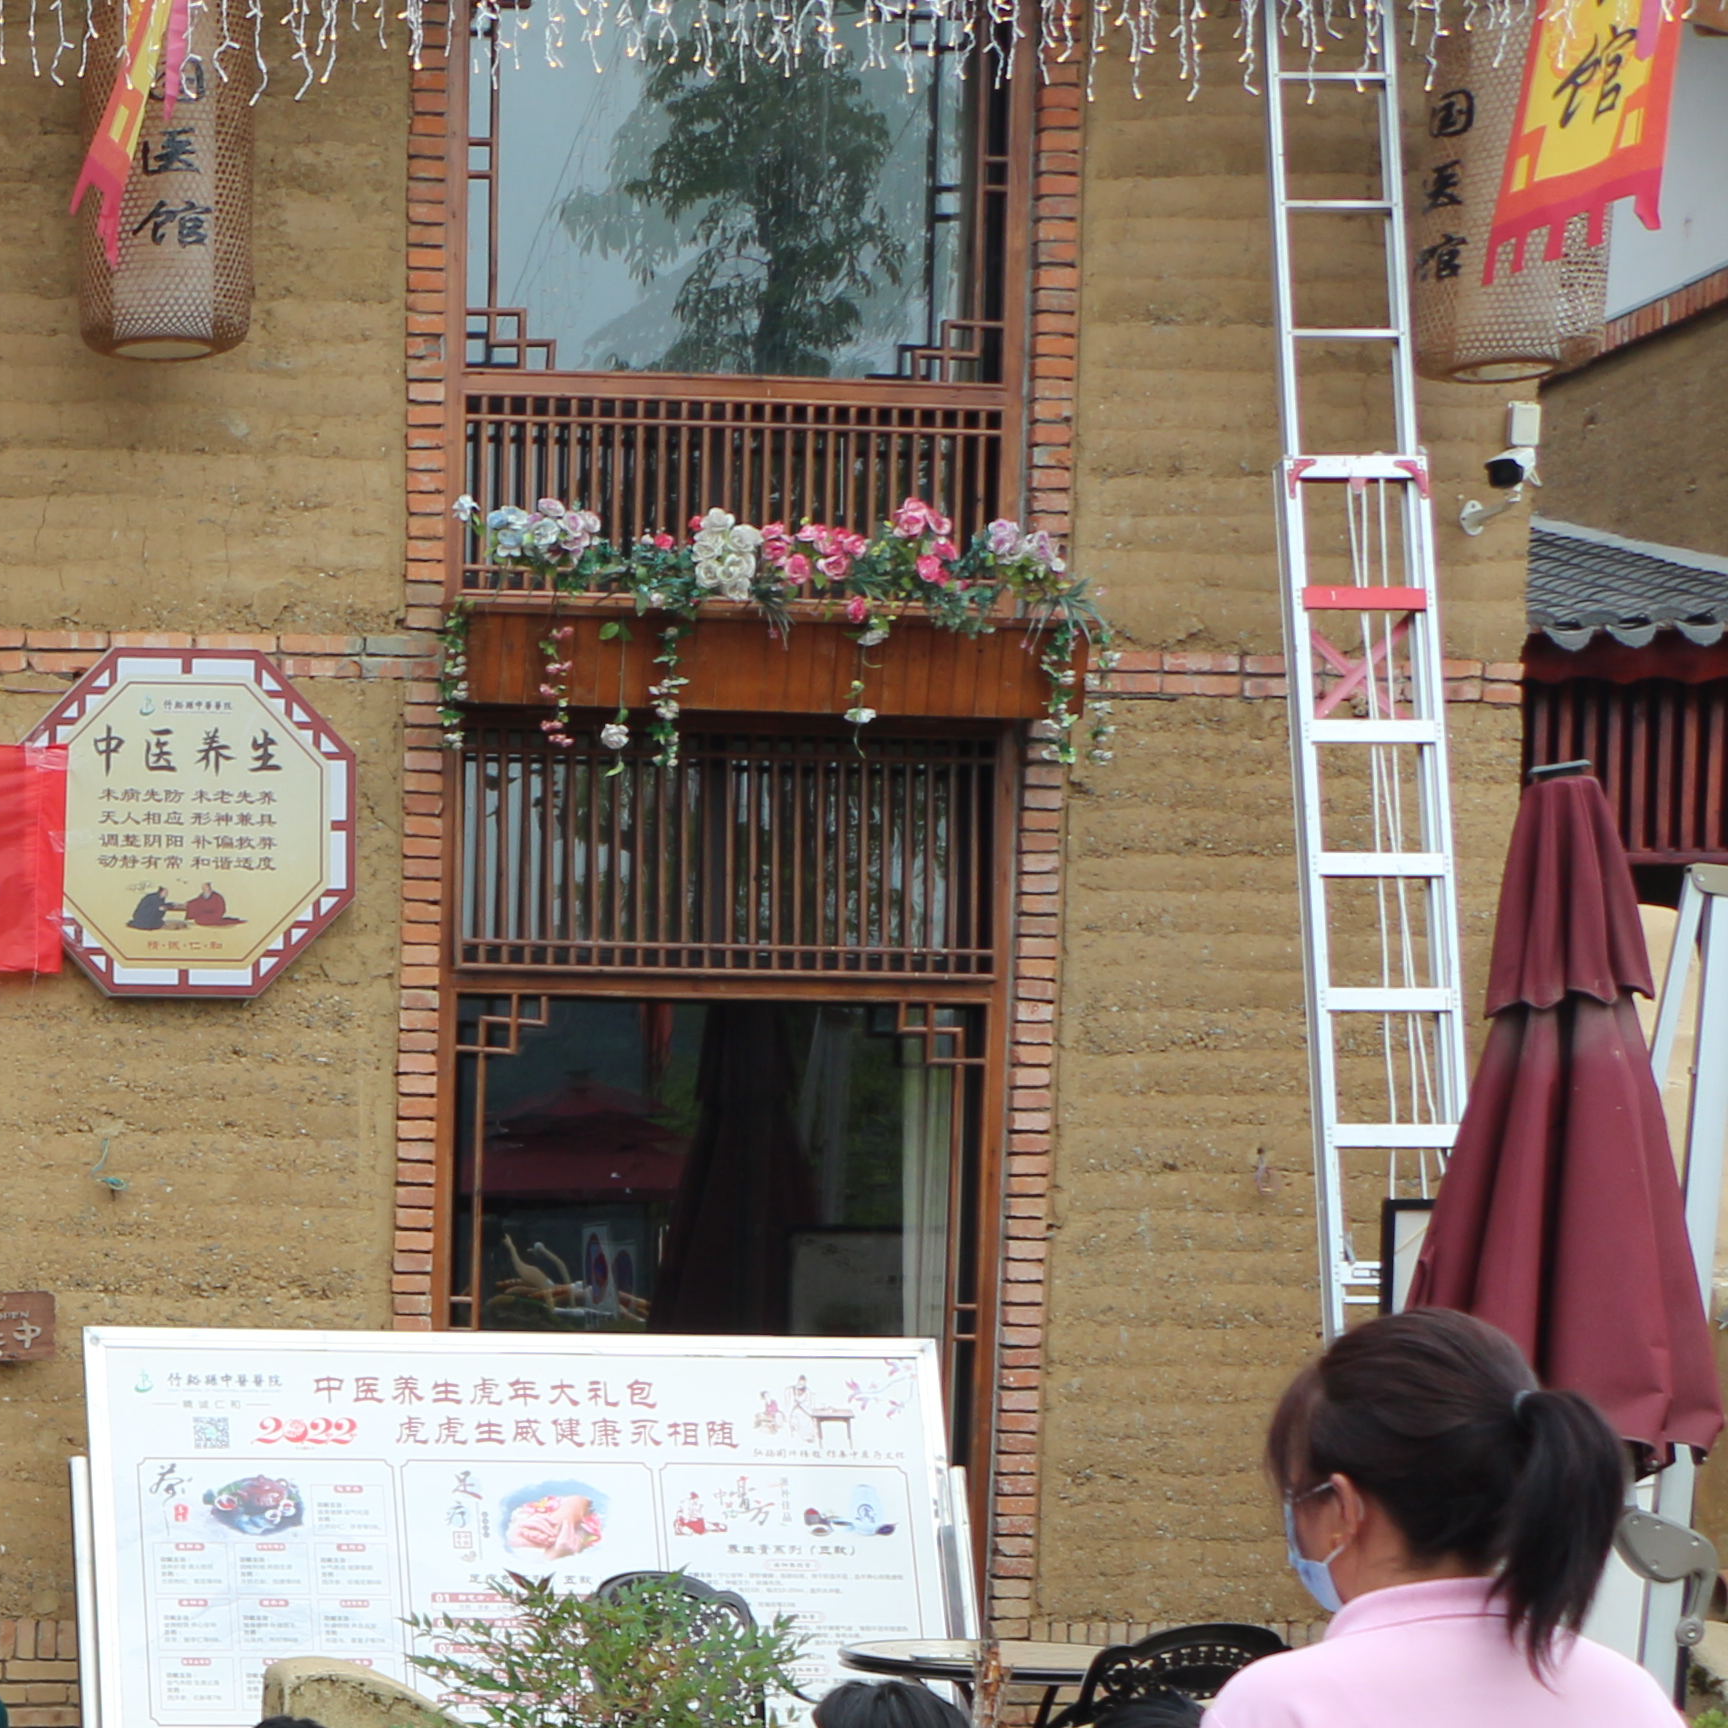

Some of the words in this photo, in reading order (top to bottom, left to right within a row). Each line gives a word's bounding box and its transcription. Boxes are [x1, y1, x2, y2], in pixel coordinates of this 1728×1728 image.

[93, 723, 283, 777] 中医养生
[99, 788, 184, 803] 未病先防
[191, 789, 277, 805] 未老先养
[99, 810, 184, 826] 天人相应
[191, 811, 277, 827] 形神兼具
[99, 833, 184, 849] 调整阴阳
[98, 854, 183, 870] 动静有常
[191, 855, 277, 871] 和谐适度
[313, 1375, 659, 1409] 中医养生虎年大礼包
[395, 1415, 741, 1449] 虎虎生威健康永相随
